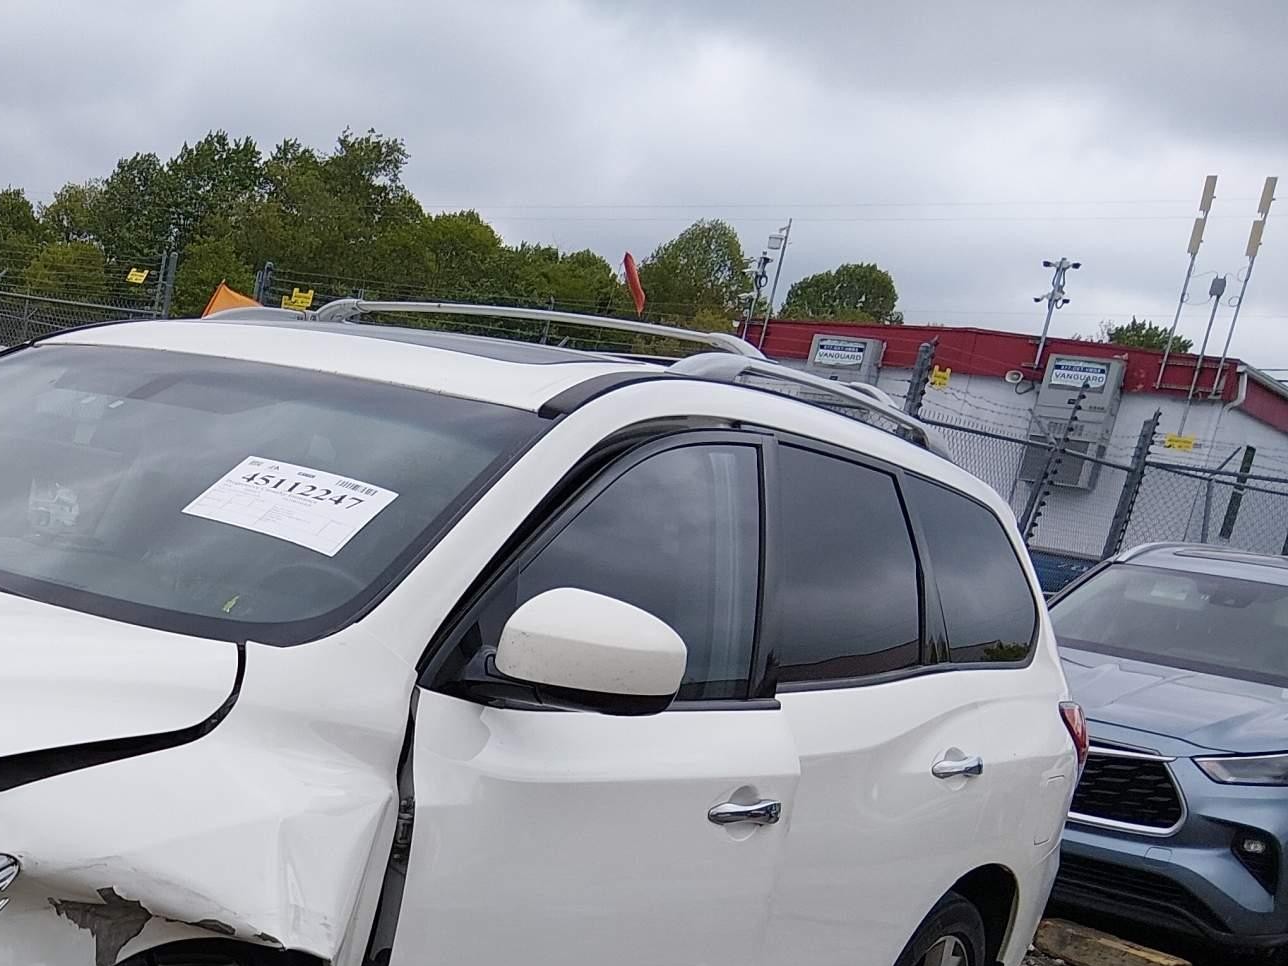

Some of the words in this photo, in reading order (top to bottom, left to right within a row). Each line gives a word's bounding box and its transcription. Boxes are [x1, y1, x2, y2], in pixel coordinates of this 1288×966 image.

[818, 351, 862, 361] VANGUARD
[1054, 371, 1105, 383] VANGUARD
[241, 472, 366, 510] 45112247
